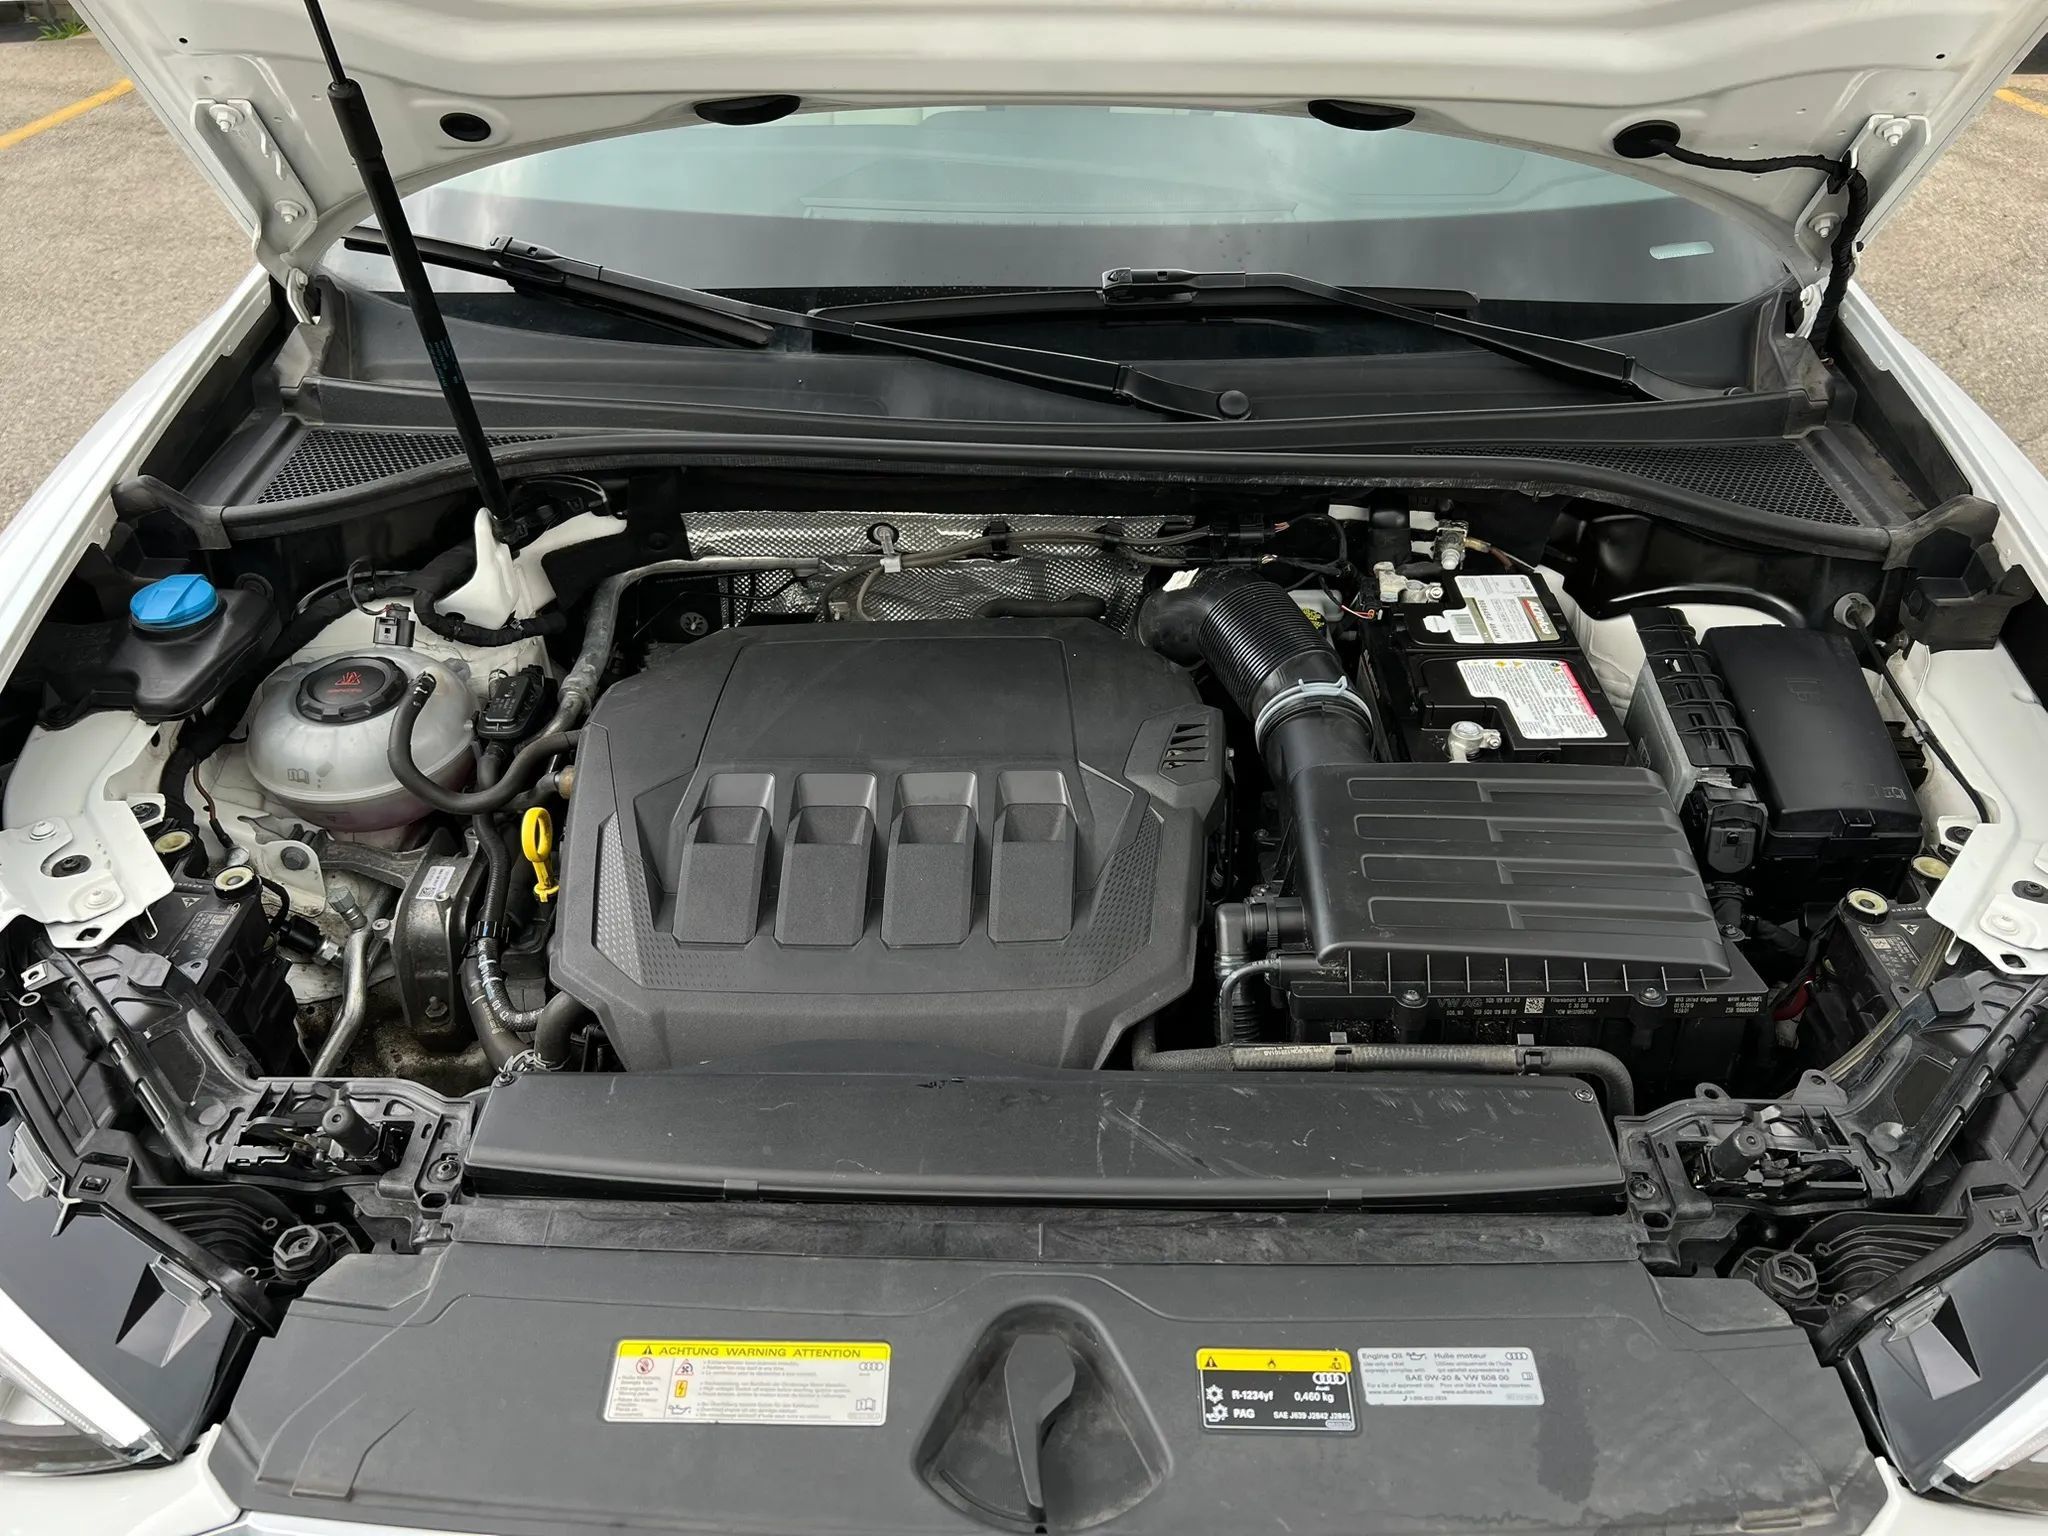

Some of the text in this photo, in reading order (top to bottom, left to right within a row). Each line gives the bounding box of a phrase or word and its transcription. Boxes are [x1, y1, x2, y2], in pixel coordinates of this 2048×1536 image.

[658, 1346, 861, 1359] ACHTUNG WARNING ATTENTION
[1361, 1352, 1403, 1361] Engine Oil
[1231, 1389, 1274, 1403] R-1234yf
[1322, 1391, 1335, 1404] kg
[1232, 1408, 1256, 1420] PAG
[1273, 1412, 1289, 1420] SAE
